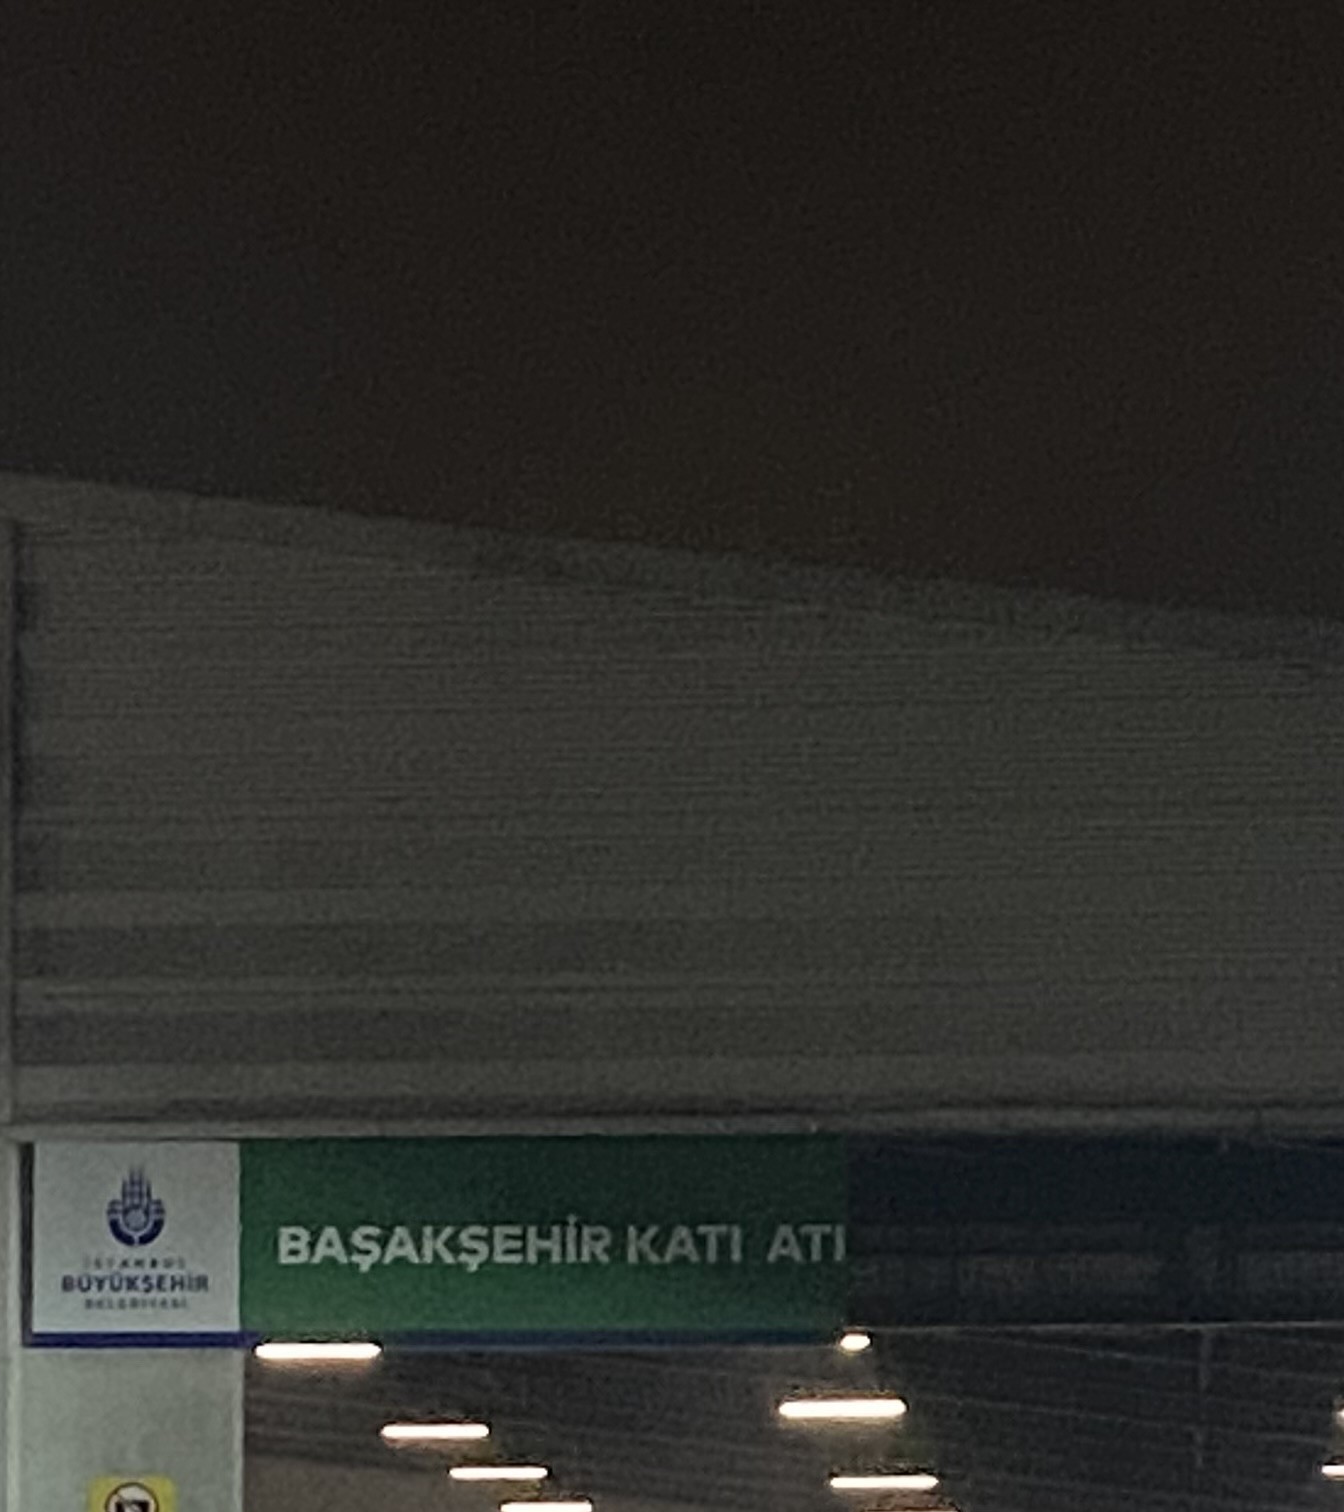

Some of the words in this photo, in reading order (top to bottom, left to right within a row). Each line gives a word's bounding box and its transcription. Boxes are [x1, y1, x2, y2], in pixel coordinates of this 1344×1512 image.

[277, 1213, 612, 1273] BAŞAKŞEHİR
[626, 1223, 743, 1264] KATI
[61, 1272, 209, 1294] BÜYÜKŞEHİR
